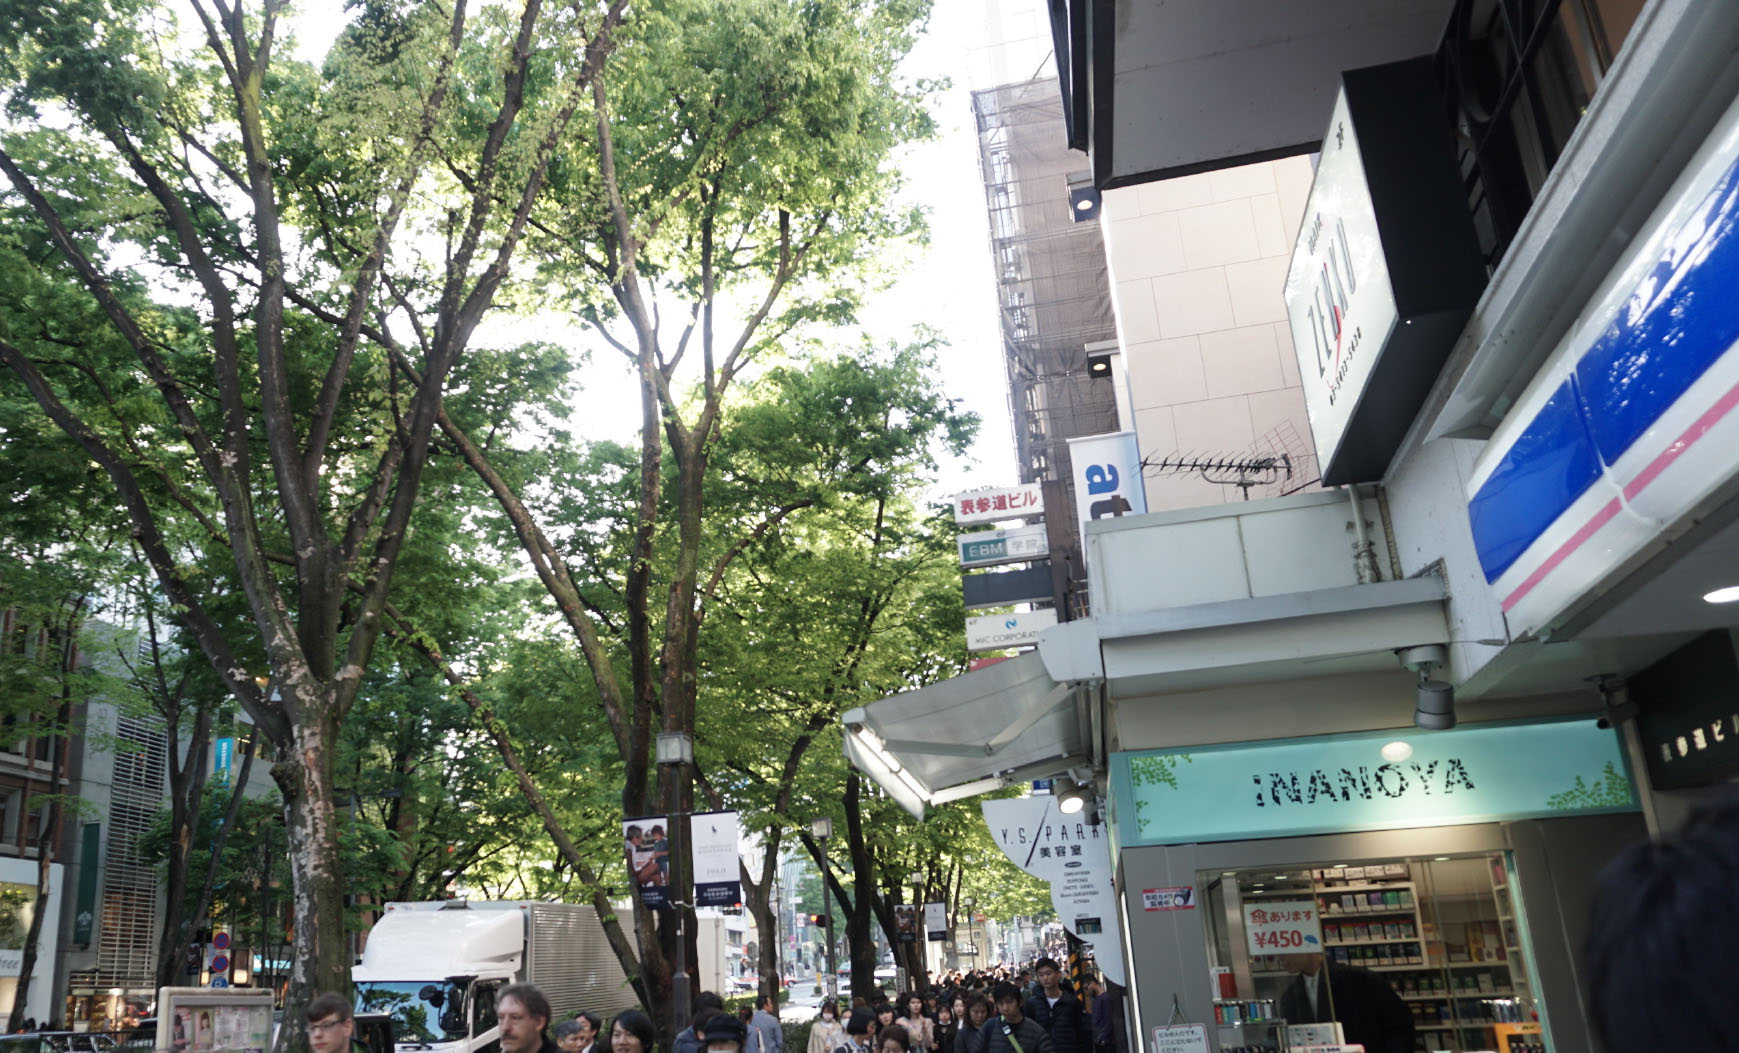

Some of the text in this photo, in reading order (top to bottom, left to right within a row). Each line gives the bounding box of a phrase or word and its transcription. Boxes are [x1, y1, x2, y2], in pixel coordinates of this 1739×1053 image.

[960, 490, 1037, 515] 表参道ビル
[969, 542, 1003, 557] EBM
[992, 630, 1039, 642] CORPORAT
[1253, 758, 1475, 807] INANOYA
[1040, 845, 1082, 858] 美容室
[1250, 909, 1313, 926] 傘あります
[1254, 930, 1303, 949] ¥450
